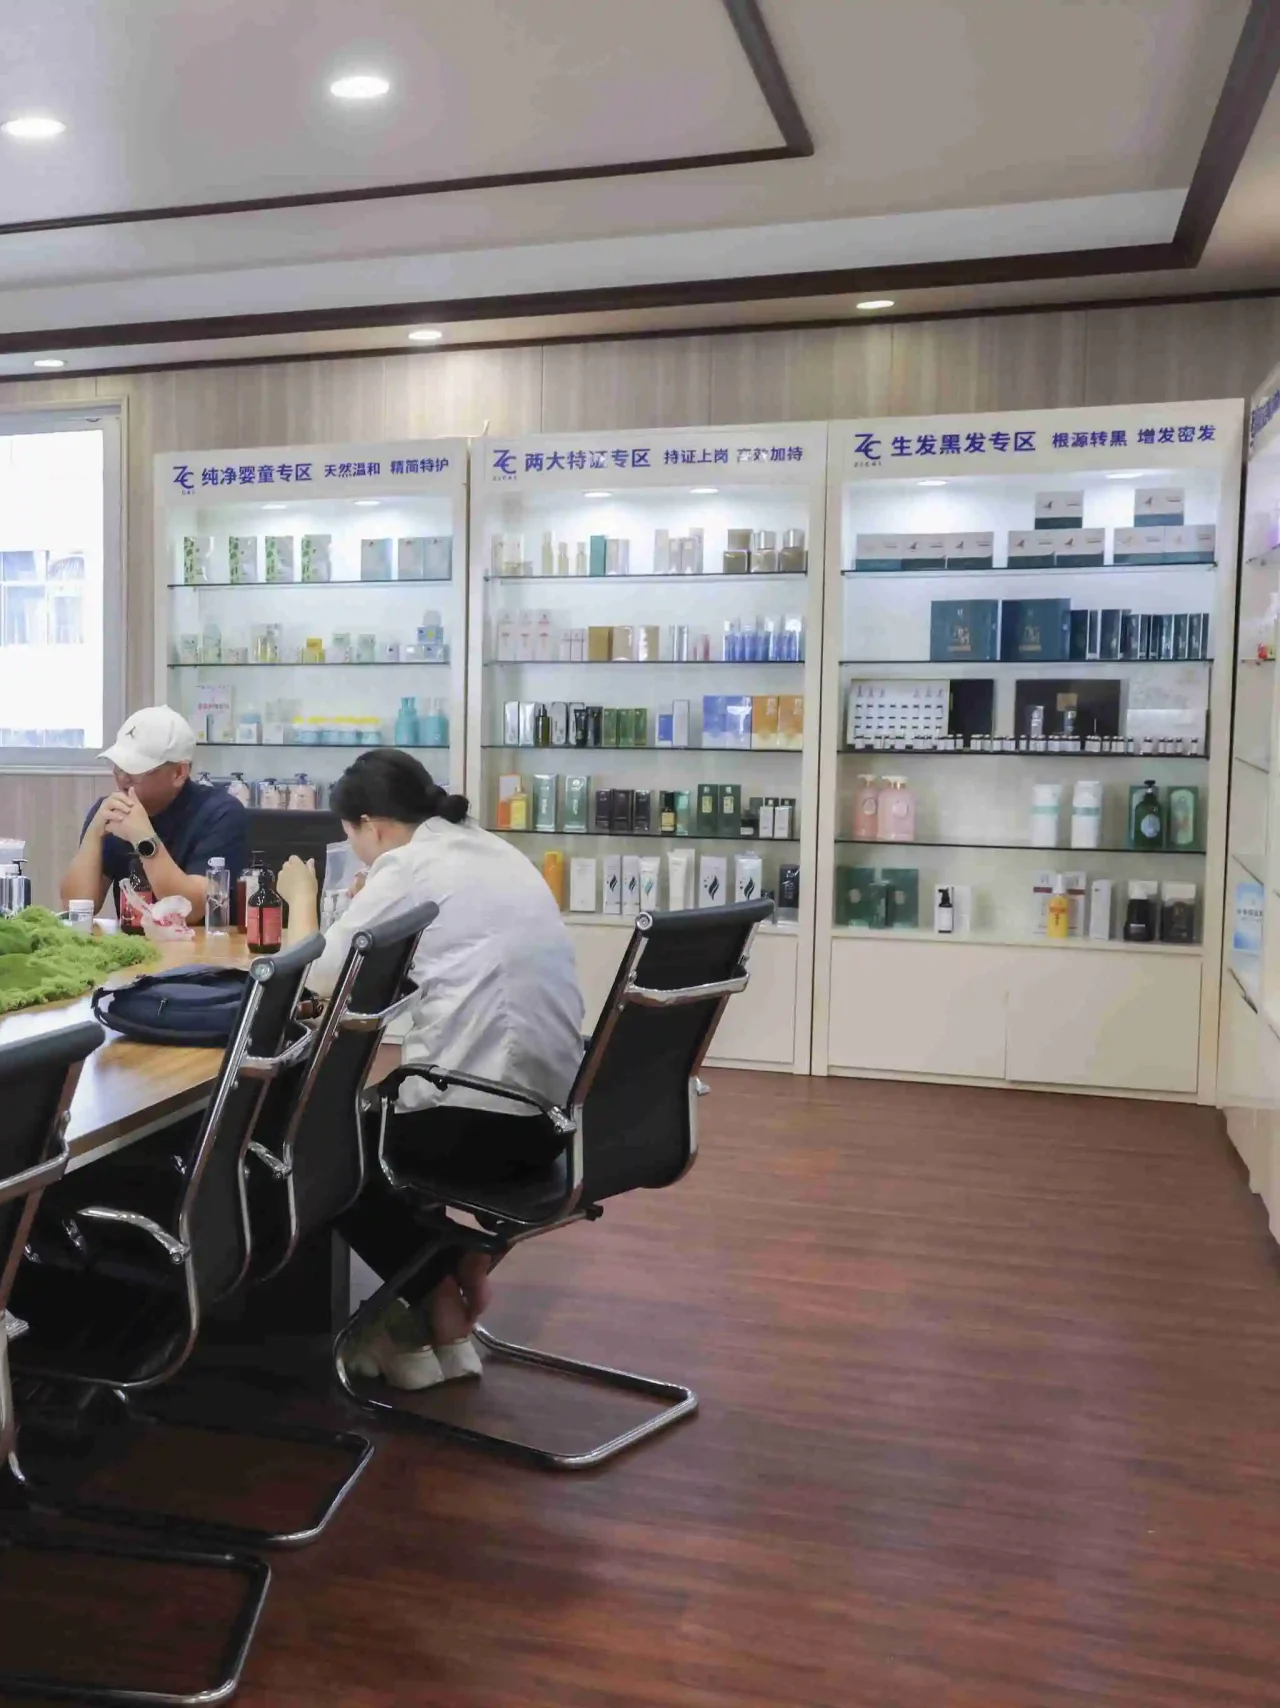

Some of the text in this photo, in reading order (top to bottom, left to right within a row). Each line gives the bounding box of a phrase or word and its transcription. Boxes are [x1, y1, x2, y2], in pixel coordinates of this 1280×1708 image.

[891, 424, 1216, 458] 生发黑发专区 根源转黑 增发密发
[664, 448, 729, 464] 持证上岗
[201, 458, 449, 486] 纯净婴童专区 天然温和 精简特护
